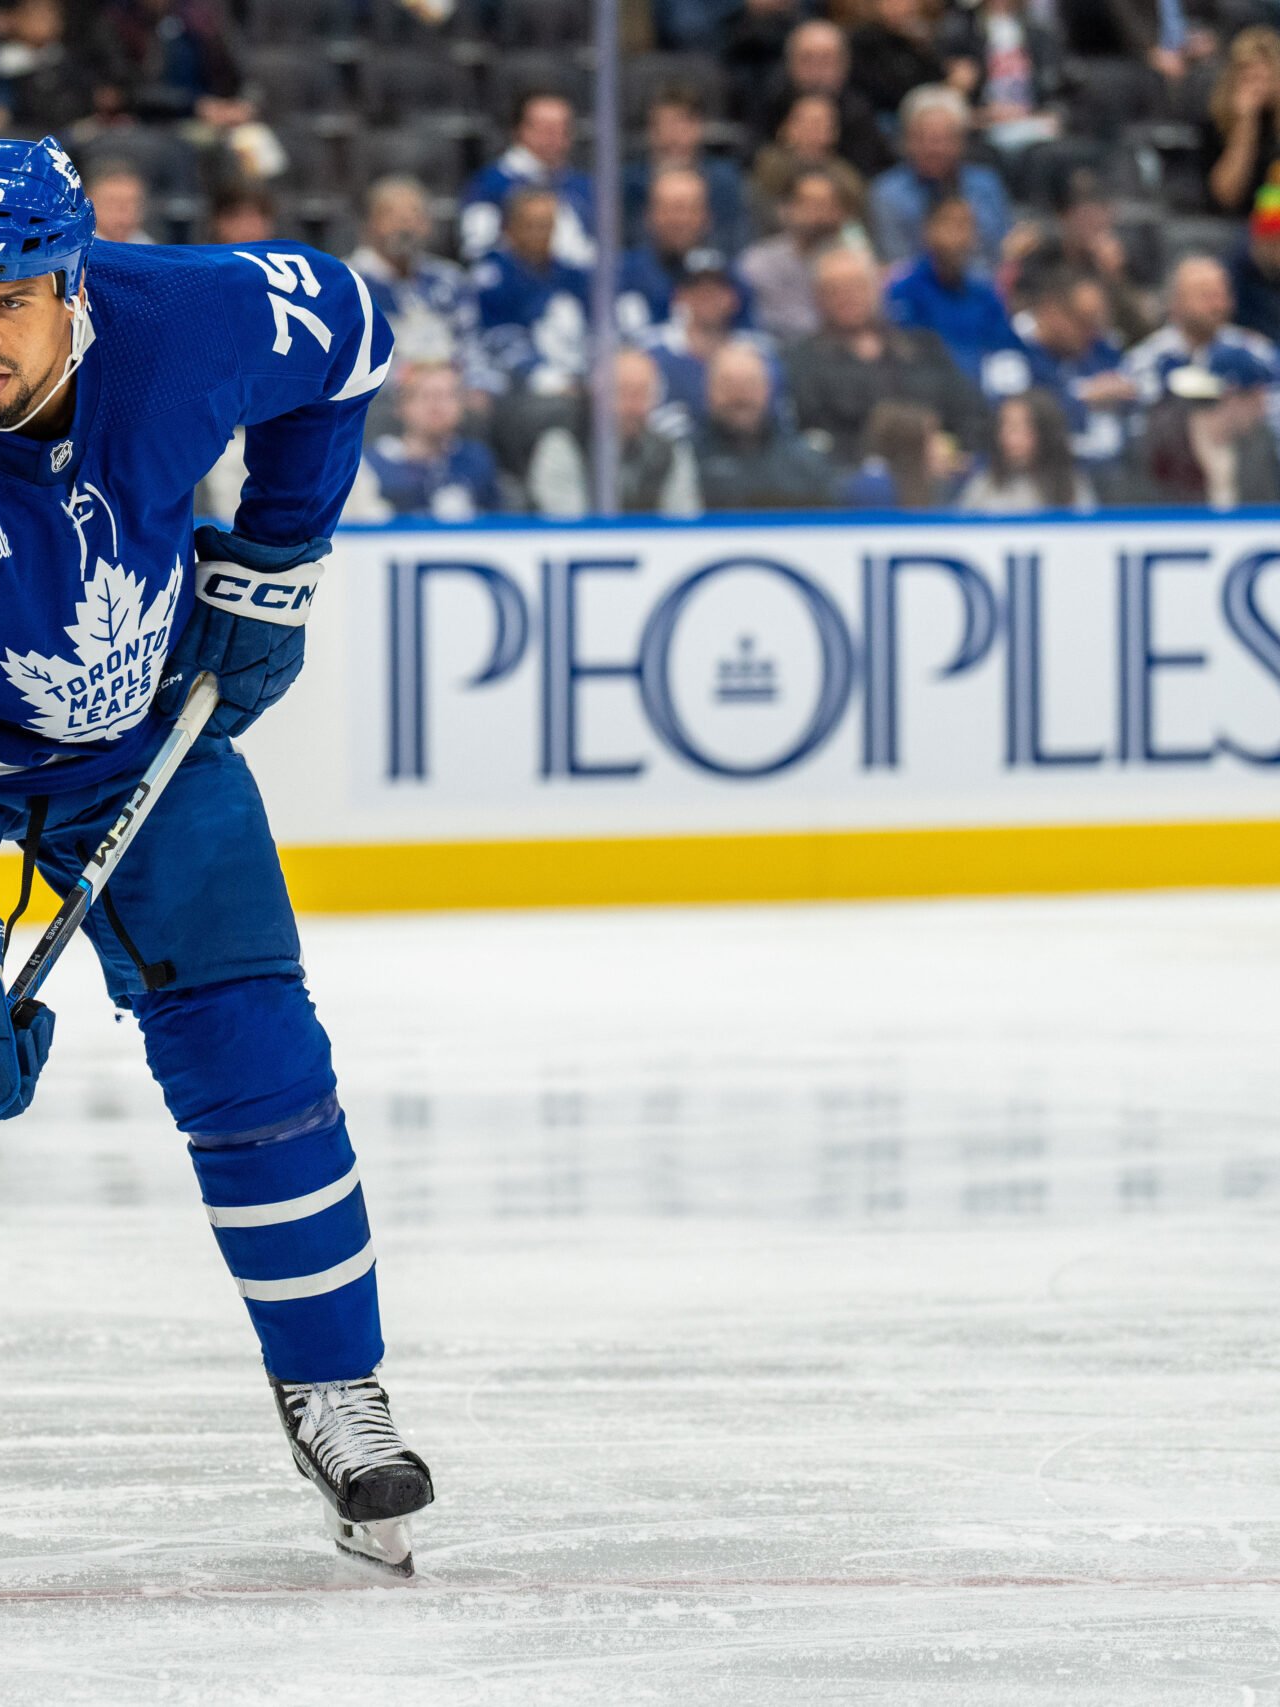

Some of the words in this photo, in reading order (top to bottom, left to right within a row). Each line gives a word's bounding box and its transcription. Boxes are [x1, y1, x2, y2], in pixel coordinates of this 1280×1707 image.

[231, 250, 334, 357] 75
[203, 573, 318, 610] CCM
[44, 625, 167, 703] TORONTO
[70, 654, 153, 713] MAPLE
[156, 672, 183, 694] CM
[67, 674, 151, 729] LEAFS
[90, 780, 151, 869] CCM
